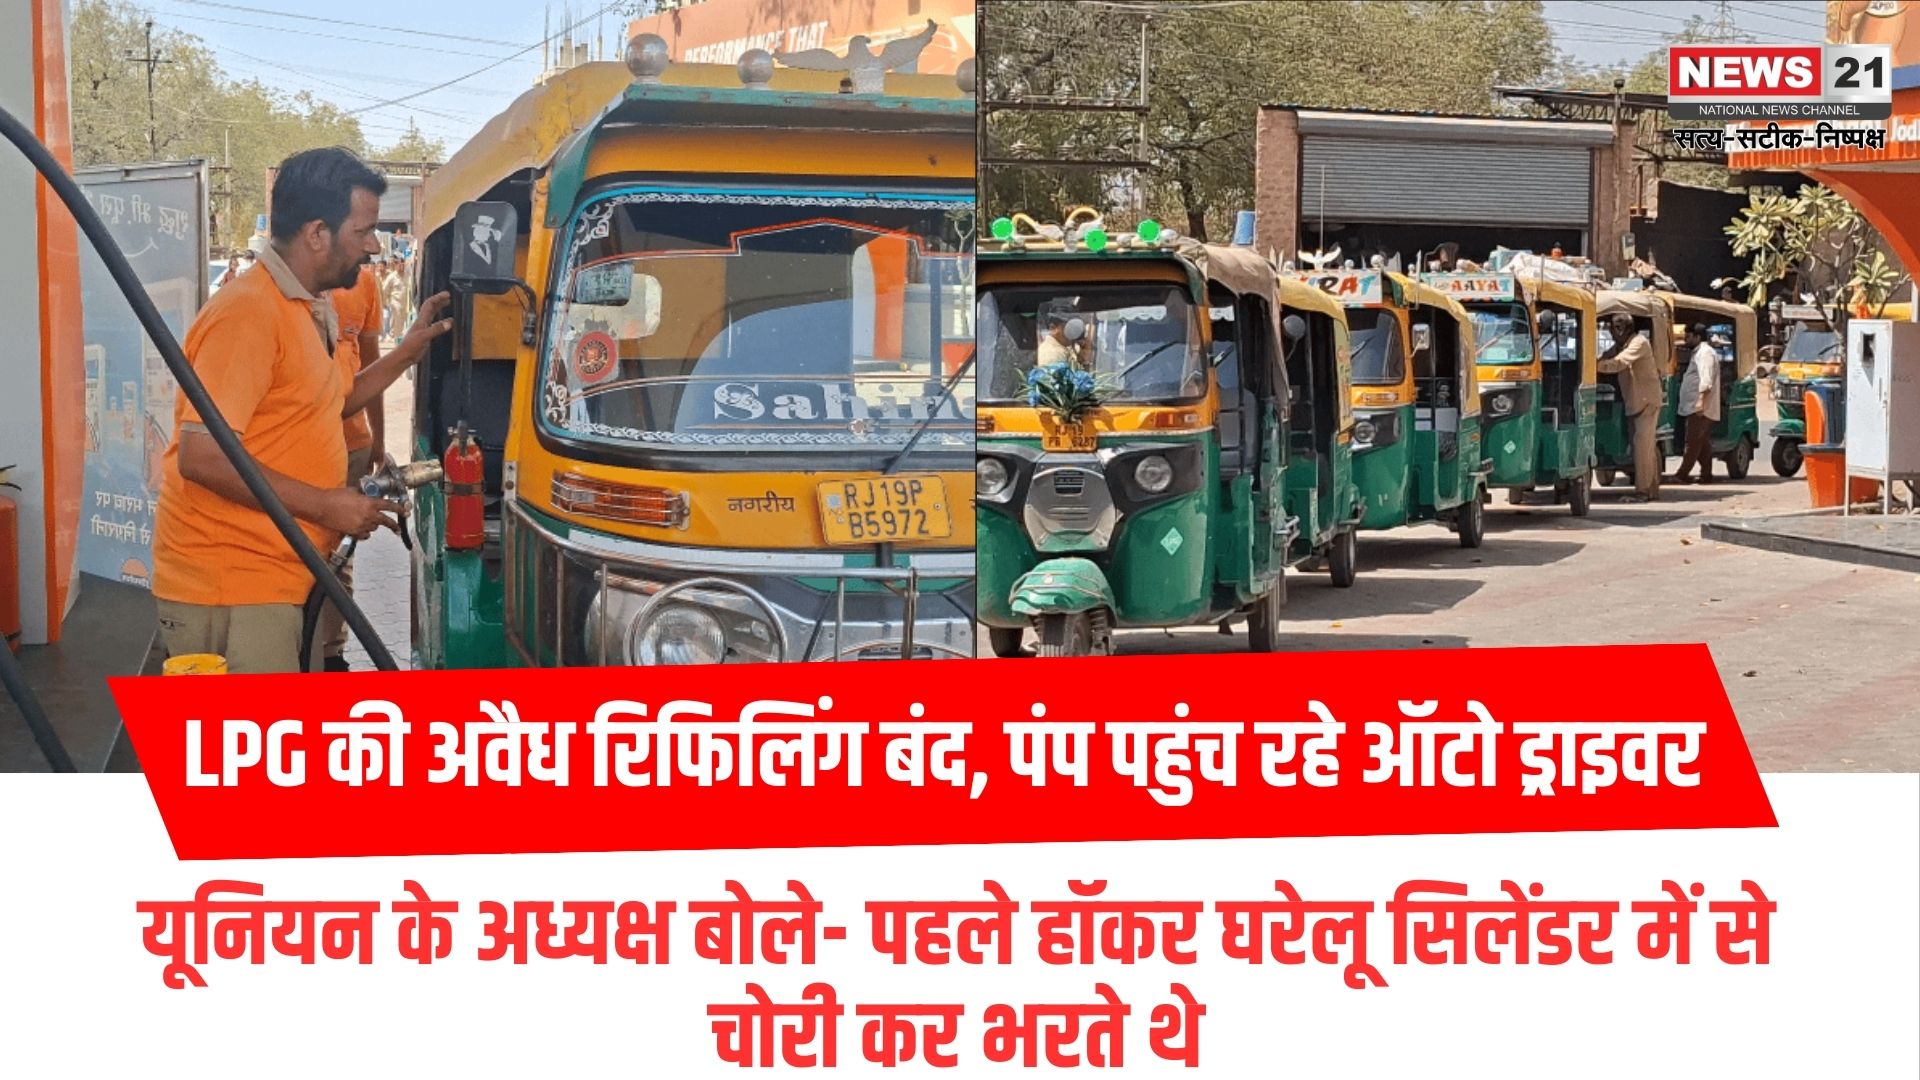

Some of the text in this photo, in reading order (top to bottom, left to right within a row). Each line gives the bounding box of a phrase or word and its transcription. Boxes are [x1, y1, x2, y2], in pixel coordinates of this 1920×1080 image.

[787, 21, 829, 53] THAT
[727, 491, 796, 514] नगरीय
[844, 479, 924, 509] RJ19P
[848, 509, 929, 538] B5972
